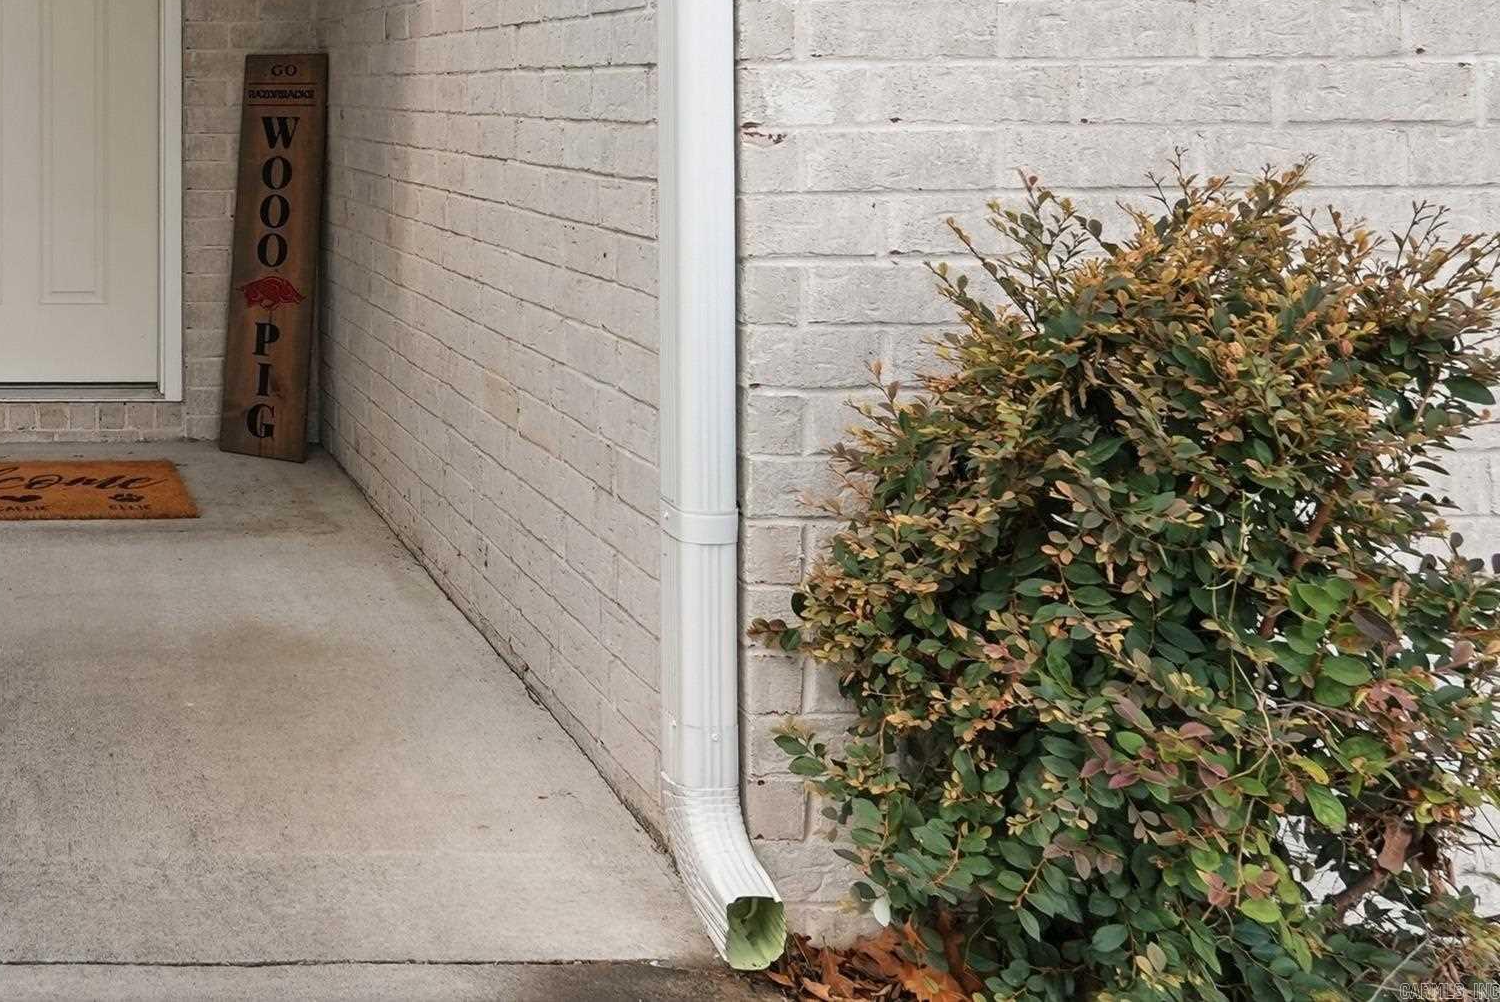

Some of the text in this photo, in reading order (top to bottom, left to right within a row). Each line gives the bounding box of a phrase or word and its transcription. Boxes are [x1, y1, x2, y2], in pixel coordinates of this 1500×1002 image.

[270, 64, 298, 77] GO
[245, 115, 301, 441] WOOO PIG
